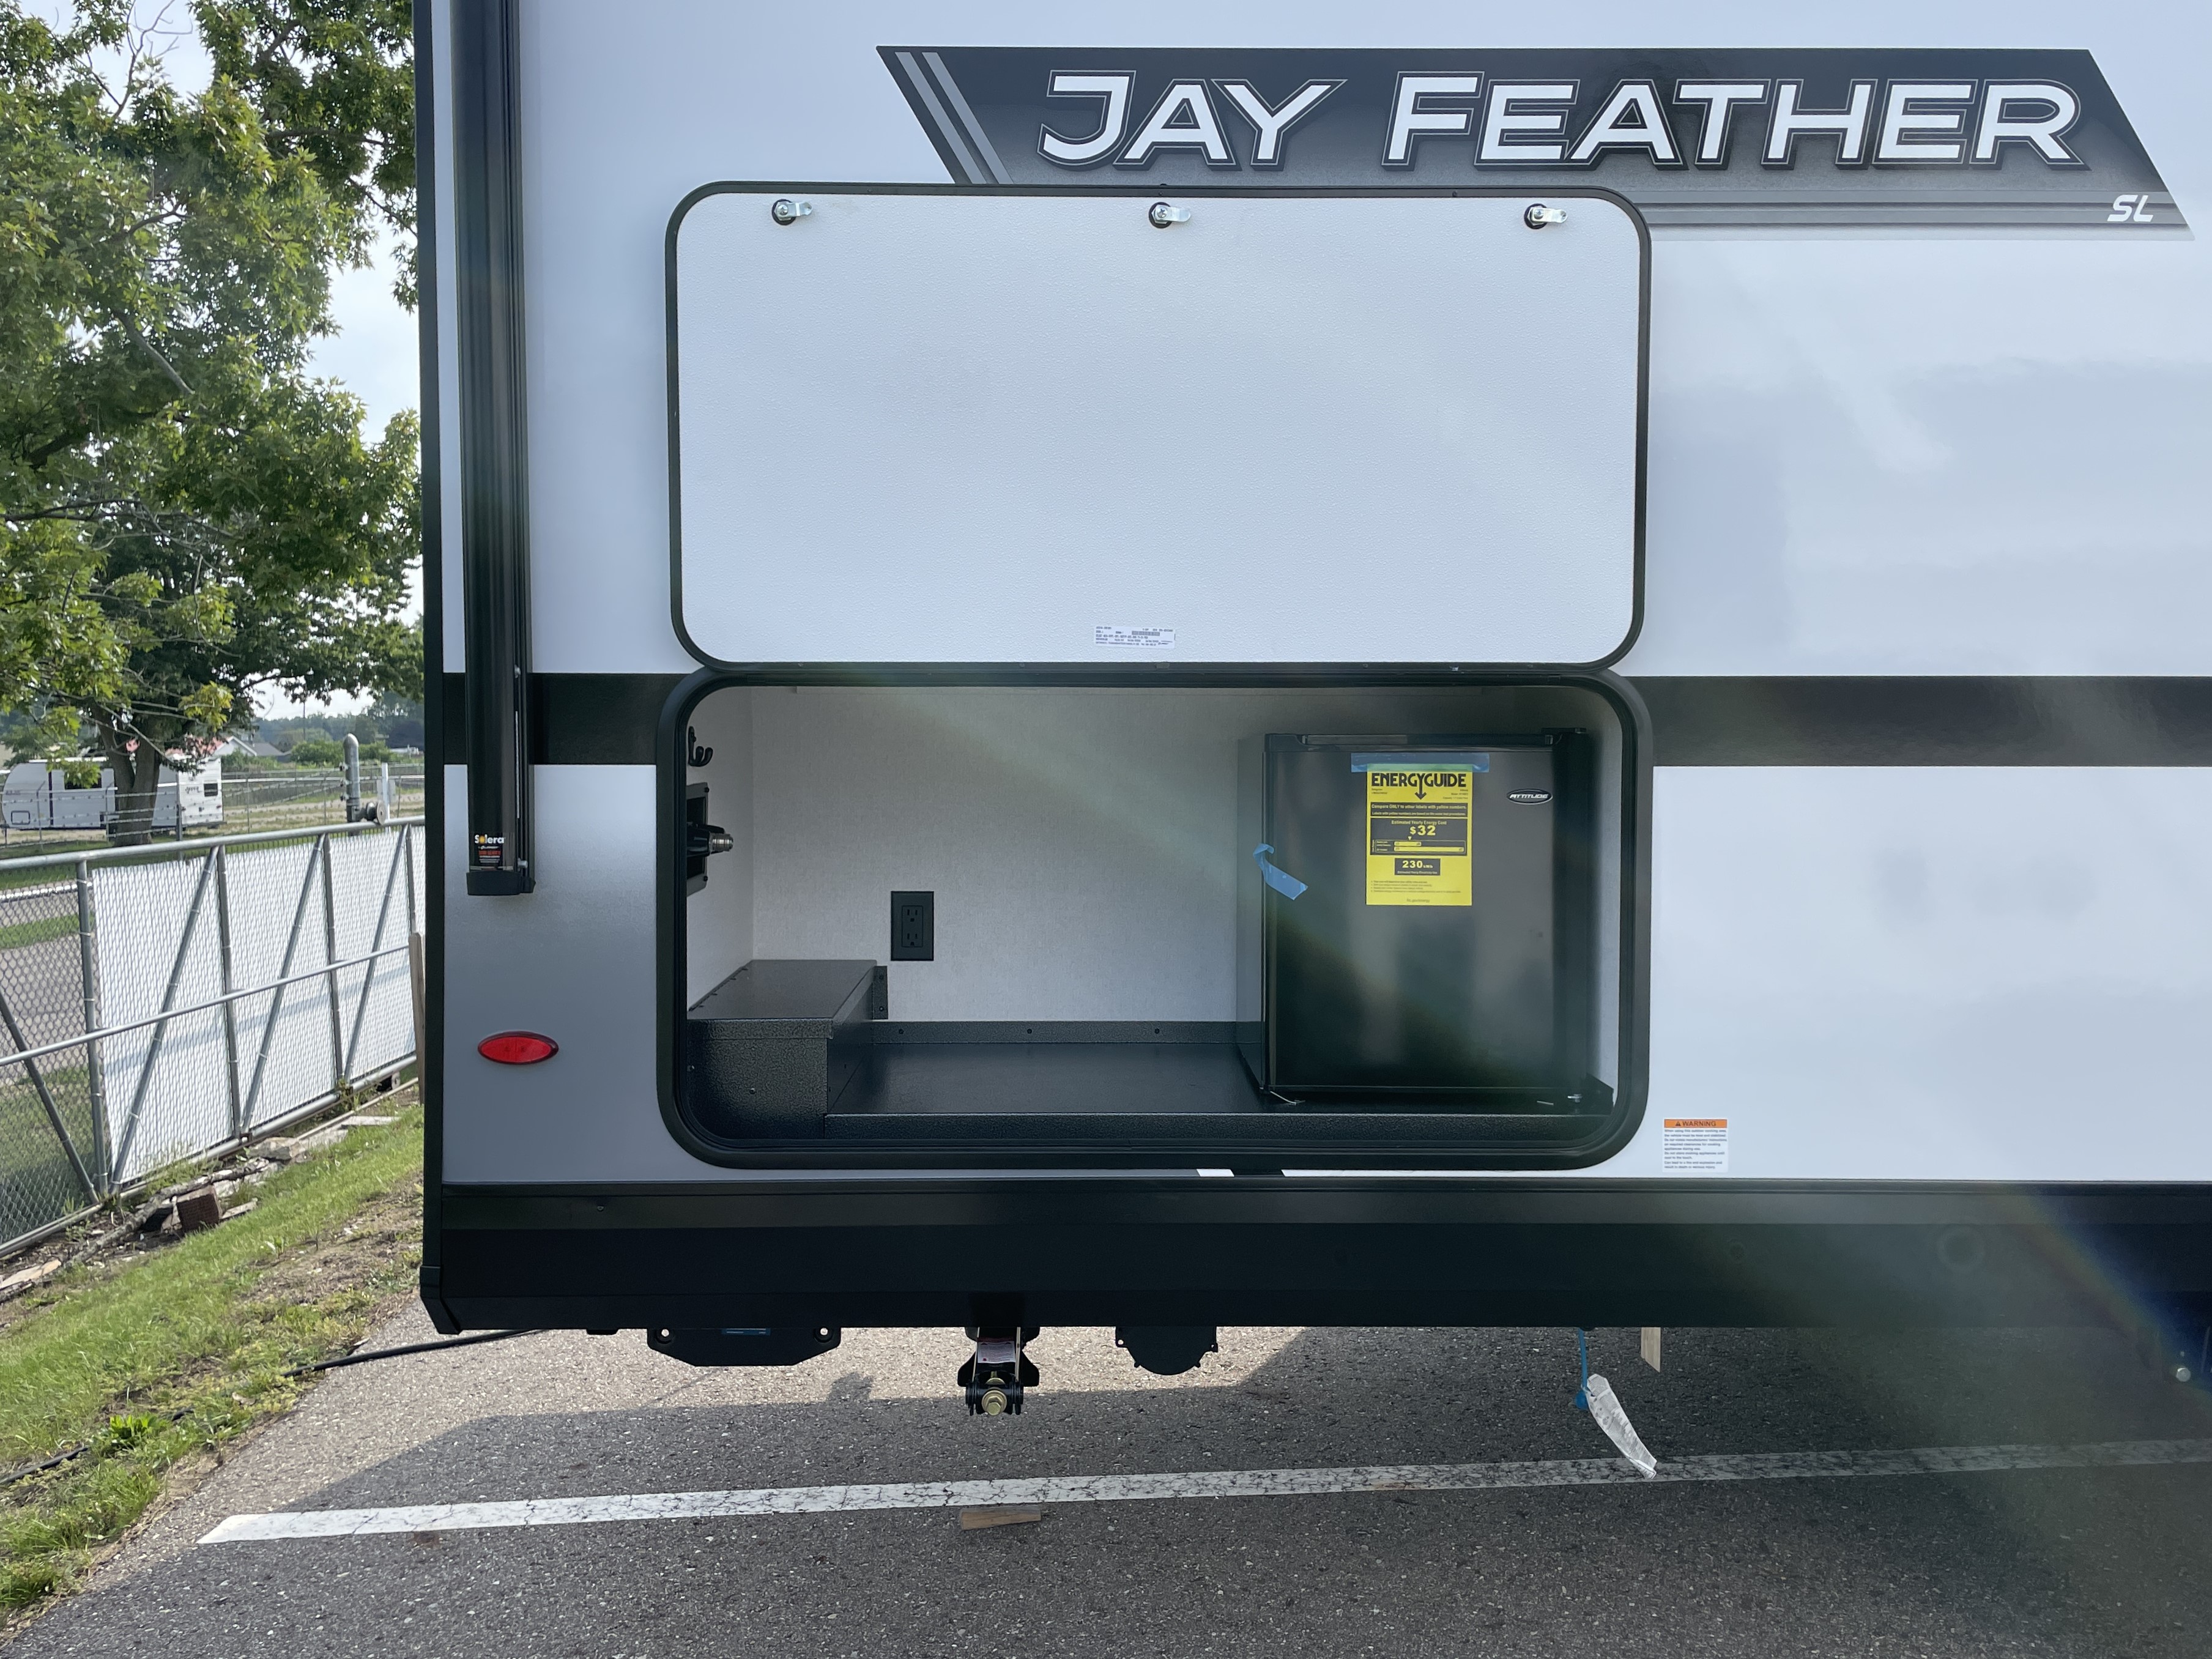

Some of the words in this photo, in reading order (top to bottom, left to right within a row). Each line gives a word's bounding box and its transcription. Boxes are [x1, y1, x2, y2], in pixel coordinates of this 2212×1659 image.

[1037, 70, 1348, 165] JAY
[1382, 71, 2084, 167] FEATHER
[2107, 194, 2154, 223] SL
[1371, 773, 1467, 788] ENERGYGUIDE
[1409, 825, 1436, 836] $32
[475, 834, 505, 844] Solera
[1402, 860, 1423, 869] 230
